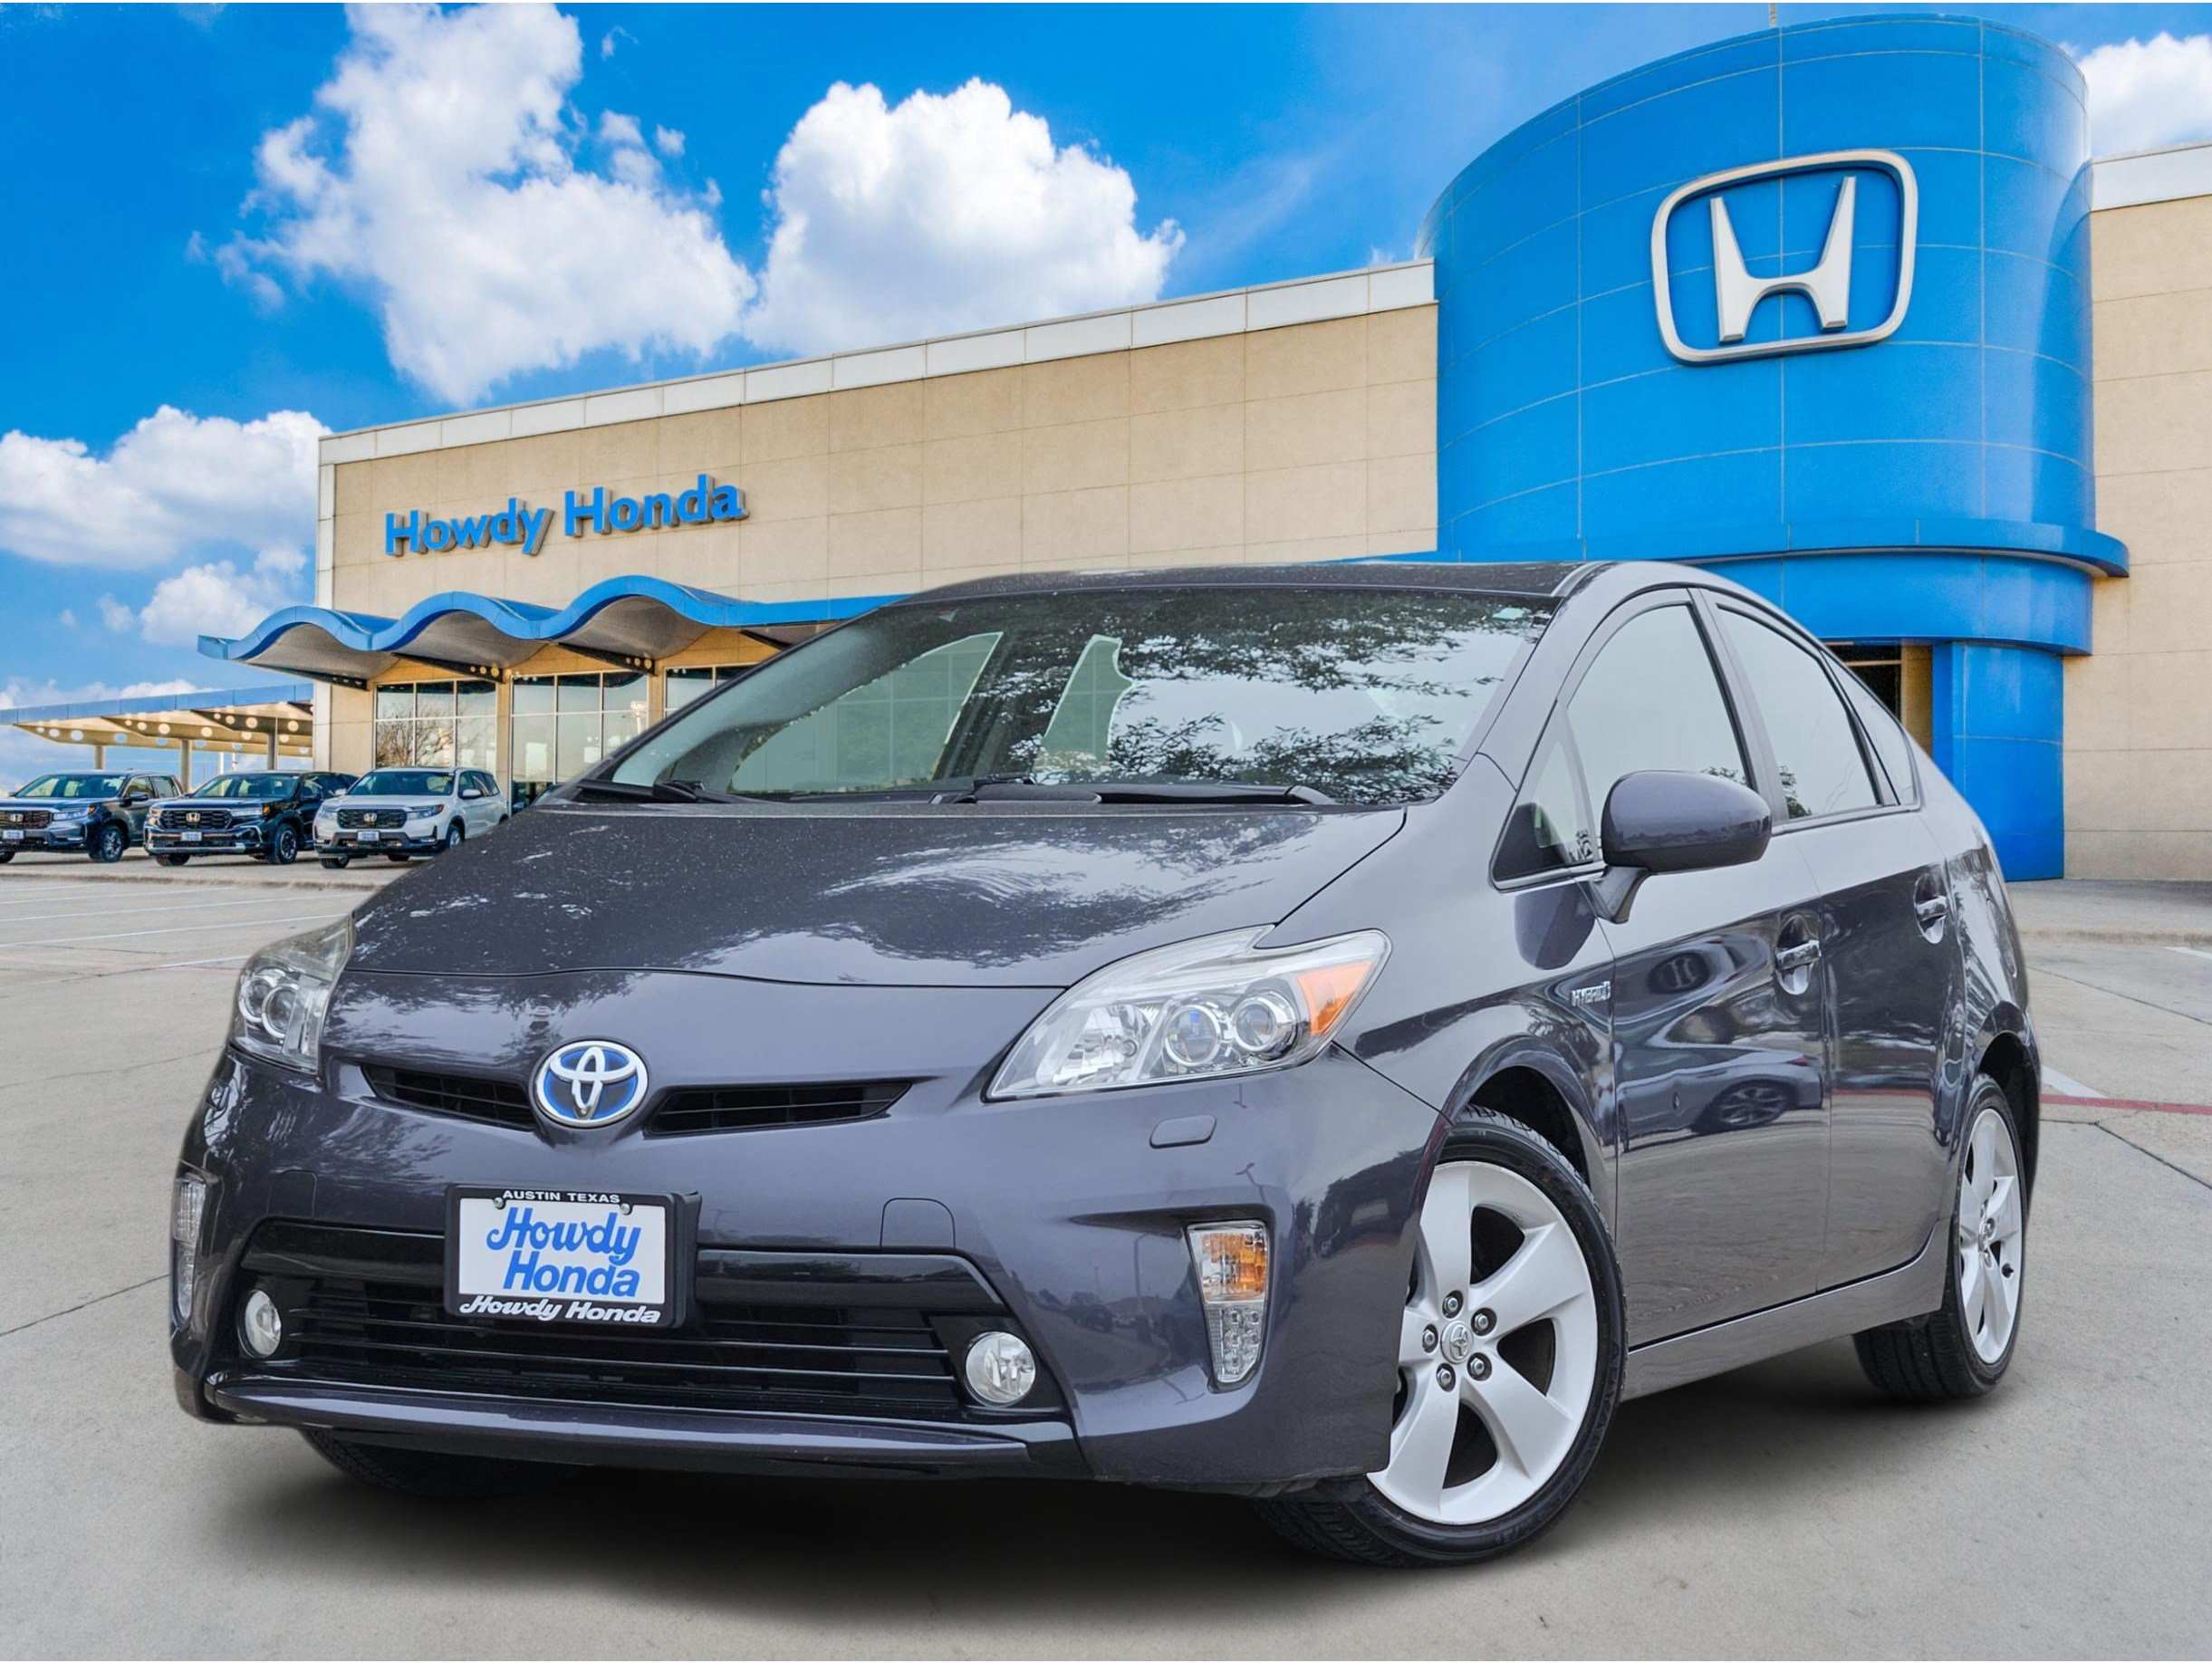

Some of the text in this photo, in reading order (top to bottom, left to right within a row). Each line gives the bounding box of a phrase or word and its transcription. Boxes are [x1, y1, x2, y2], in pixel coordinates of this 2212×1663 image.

[385, 474, 748, 556] Howdy Honda
[503, 1189, 620, 1204] AUSTIN TEXAS
[486, 1206, 641, 1266] Howdy
[503, 1250, 641, 1297] Honda
[459, 1295, 661, 1323] Howdy Honda
